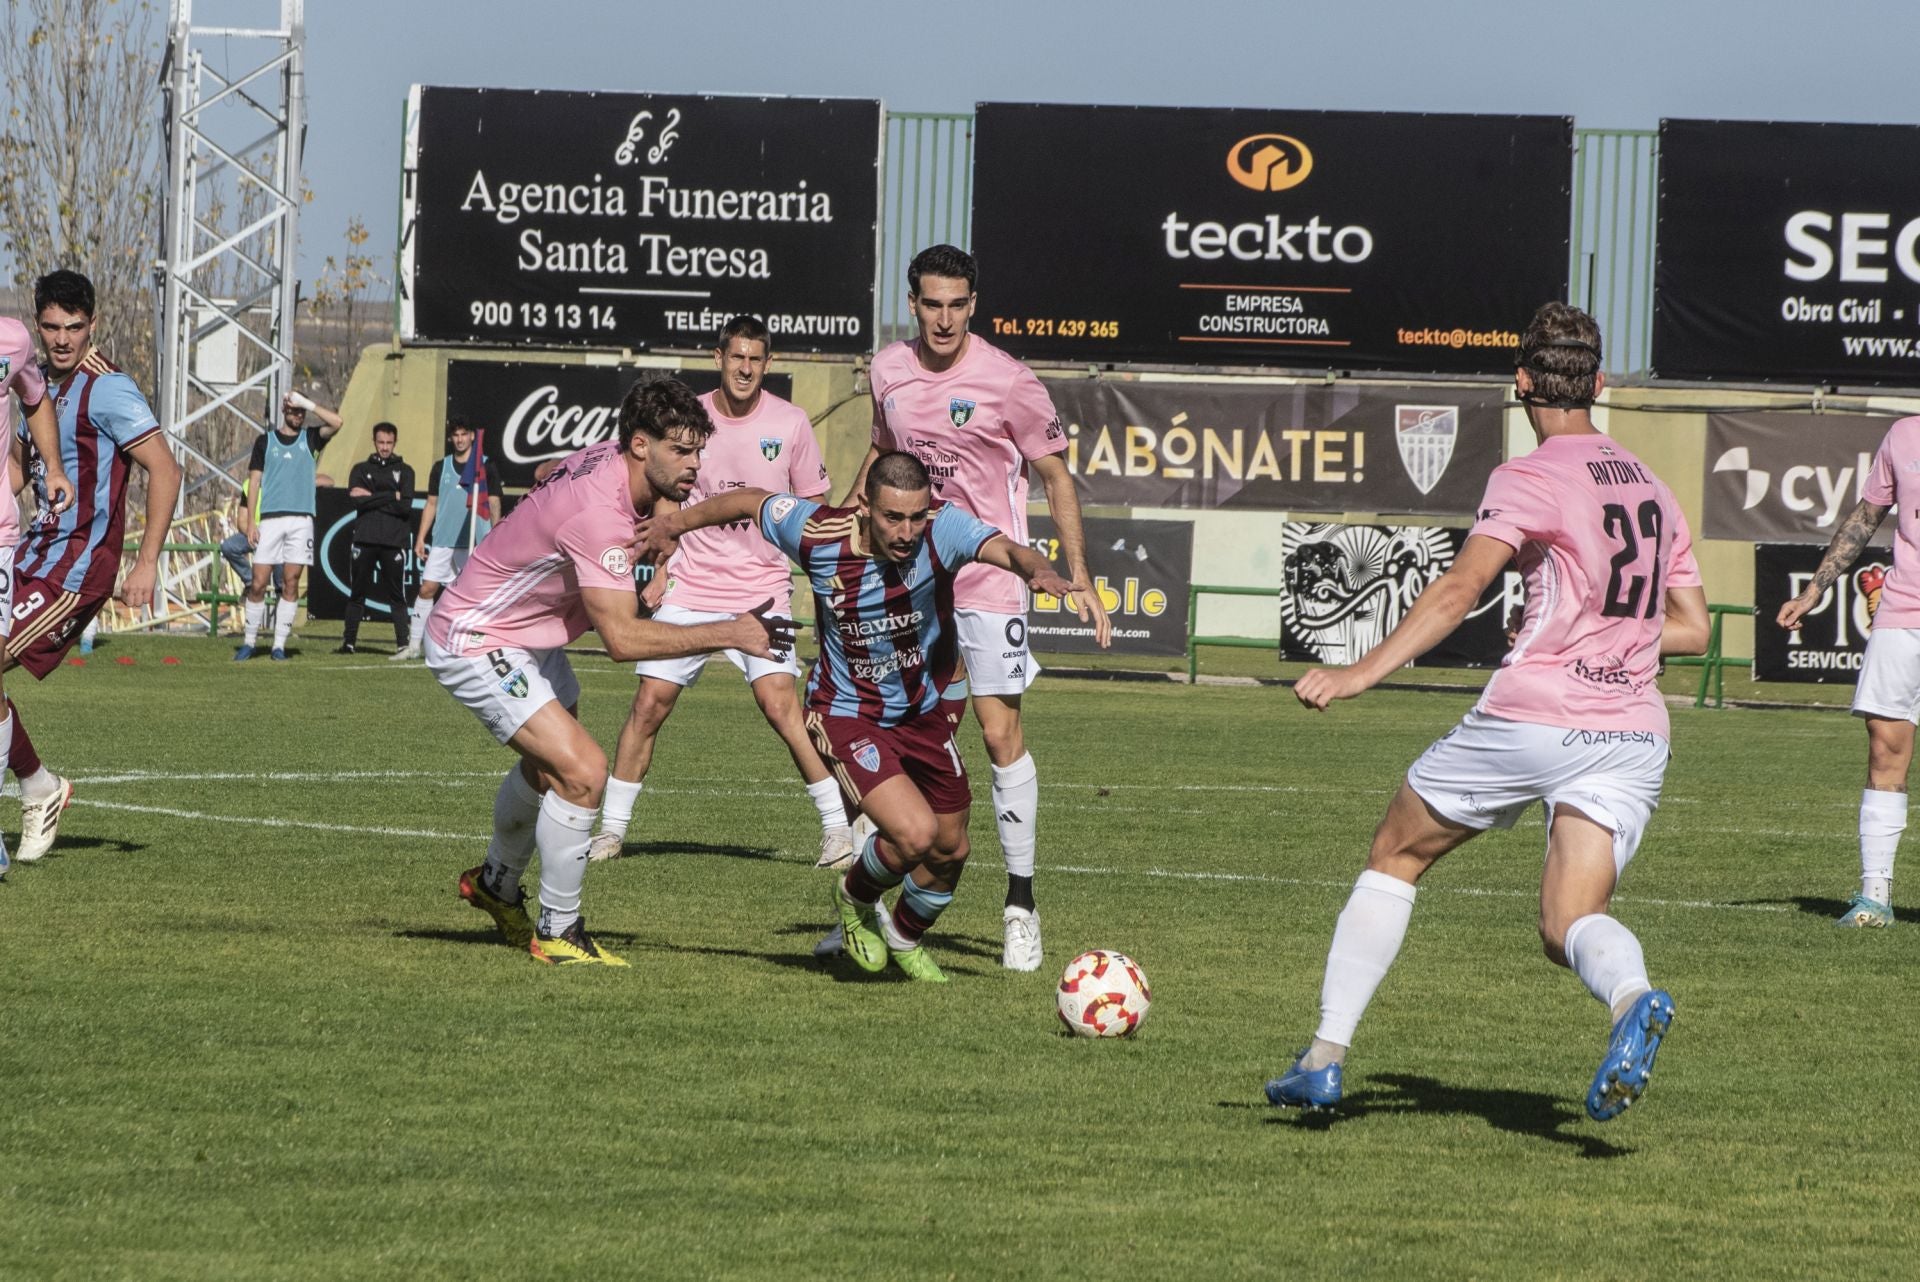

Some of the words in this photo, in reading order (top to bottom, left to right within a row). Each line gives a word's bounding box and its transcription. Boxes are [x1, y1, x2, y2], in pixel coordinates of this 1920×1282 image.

[461, 169, 627, 224] Agencia
[638, 175, 834, 223] Funeraria
[1161, 211, 1373, 264] teckto
[517, 229, 628, 273] Santa
[639, 233, 772, 279] Teresa
[470, 301, 513, 326] 900
[520, 302, 548, 327] 13
[554, 304, 582, 329] 13
[588, 305, 617, 330] 14
[1226, 295, 1304, 314] EMPRESA
[1782, 297, 1834, 322] Obra
[1838, 298, 1881, 323] Civil
[767, 314, 861, 336] GRATUITO
[993, 317, 1023, 335] Tel.
[1026, 318, 1054, 336] 921
[1057, 320, 1087, 337] 439
[1090, 321, 1119, 338] 365
[1199, 315, 1330, 335] CONSTRUCTORA
[1781, 452, 1898, 527] cyl
[12, 591, 46, 621] 3
